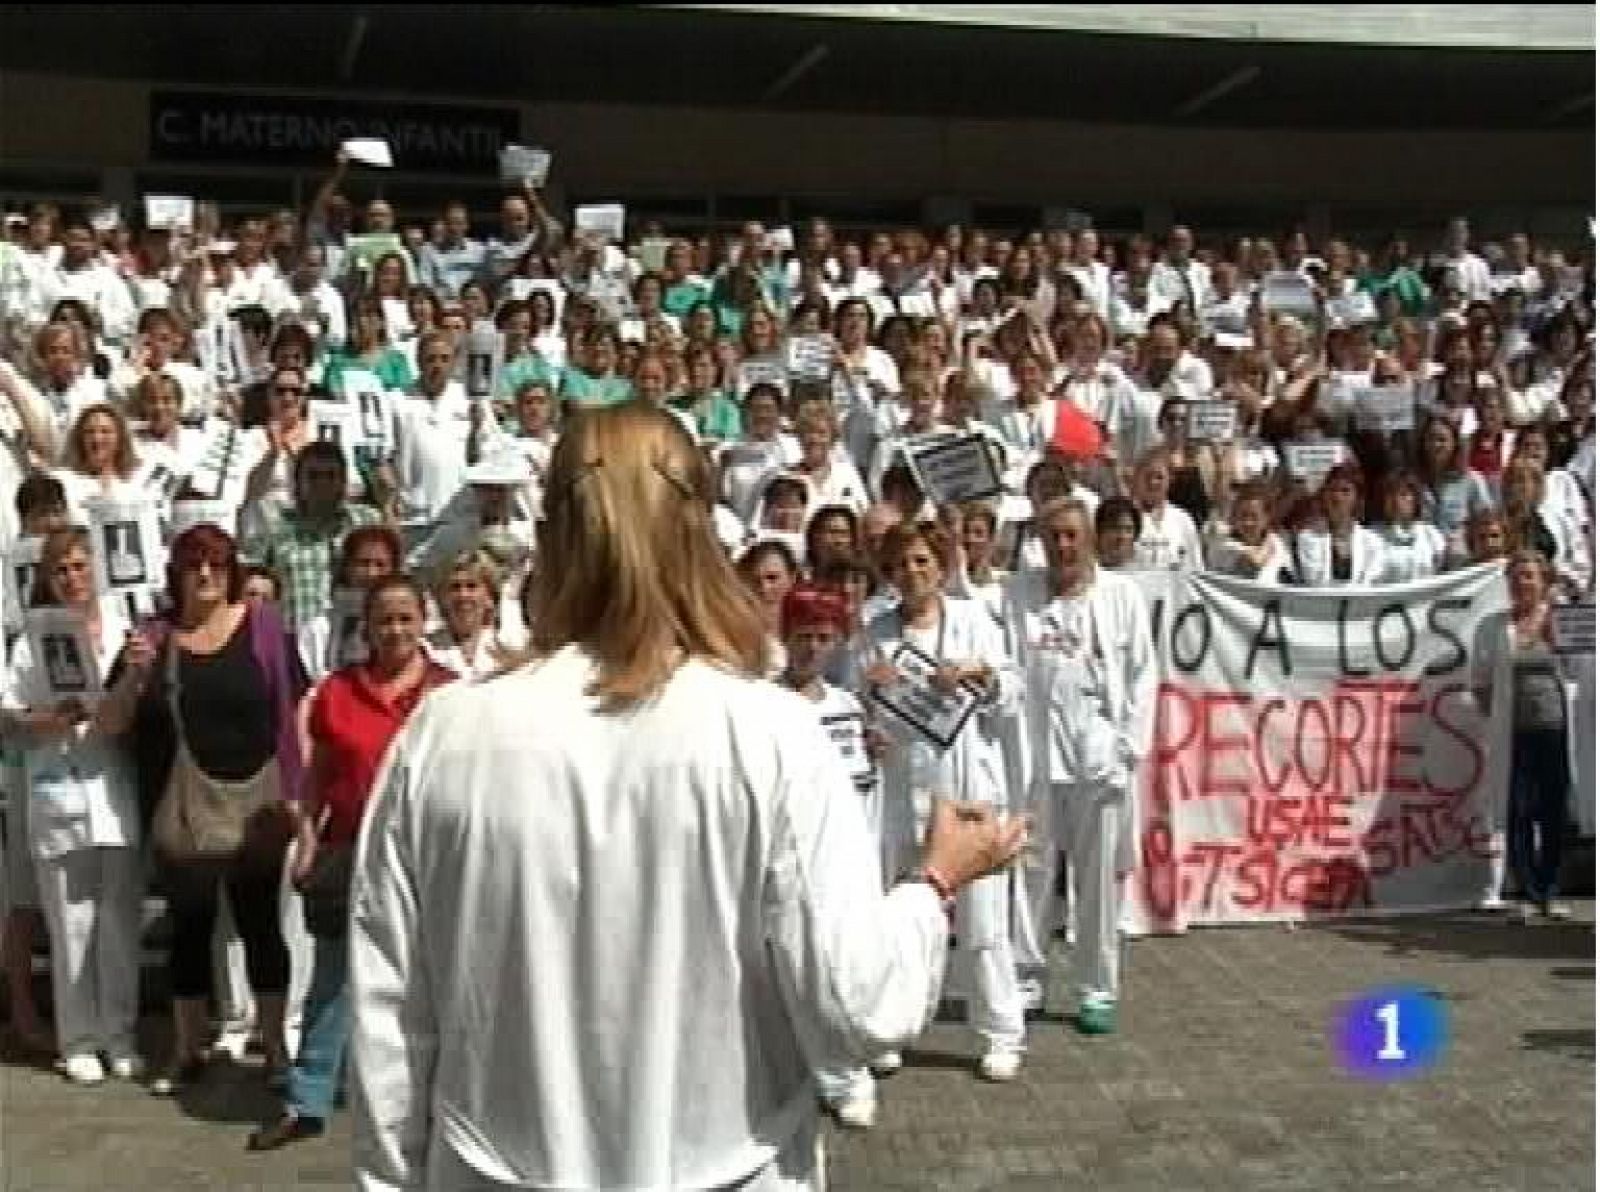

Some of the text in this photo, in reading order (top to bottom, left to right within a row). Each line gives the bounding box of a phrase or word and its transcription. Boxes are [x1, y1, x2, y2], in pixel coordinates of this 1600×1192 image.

[1244, 599, 1292, 680] A
[1337, 597, 1475, 677] LOS
[1155, 681, 1485, 802] RECORTES
